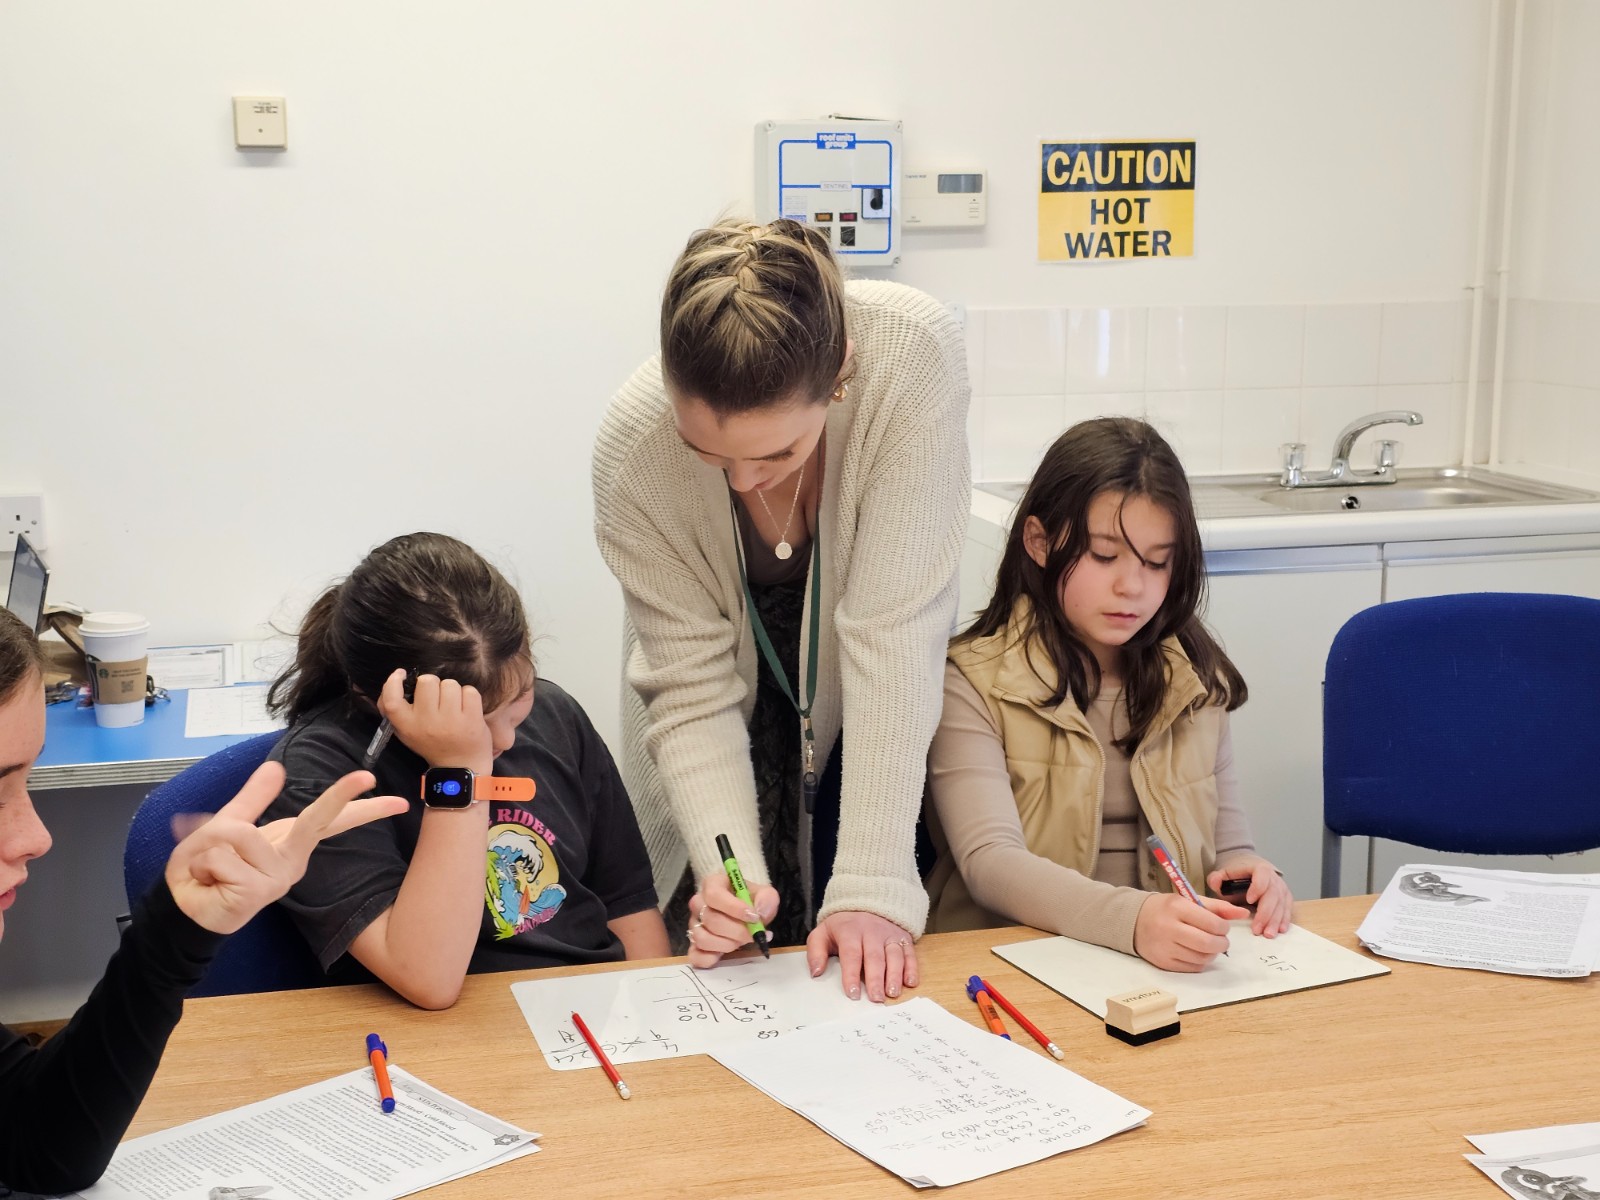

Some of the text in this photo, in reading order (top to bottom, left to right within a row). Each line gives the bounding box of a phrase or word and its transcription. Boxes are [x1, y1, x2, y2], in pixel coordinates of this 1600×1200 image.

[1047, 149, 1192, 186] CAUTION
[1090, 198, 1151, 225] HOT
[1064, 230, 1172, 259] WATER
[497, 808, 557, 846] RIDER
